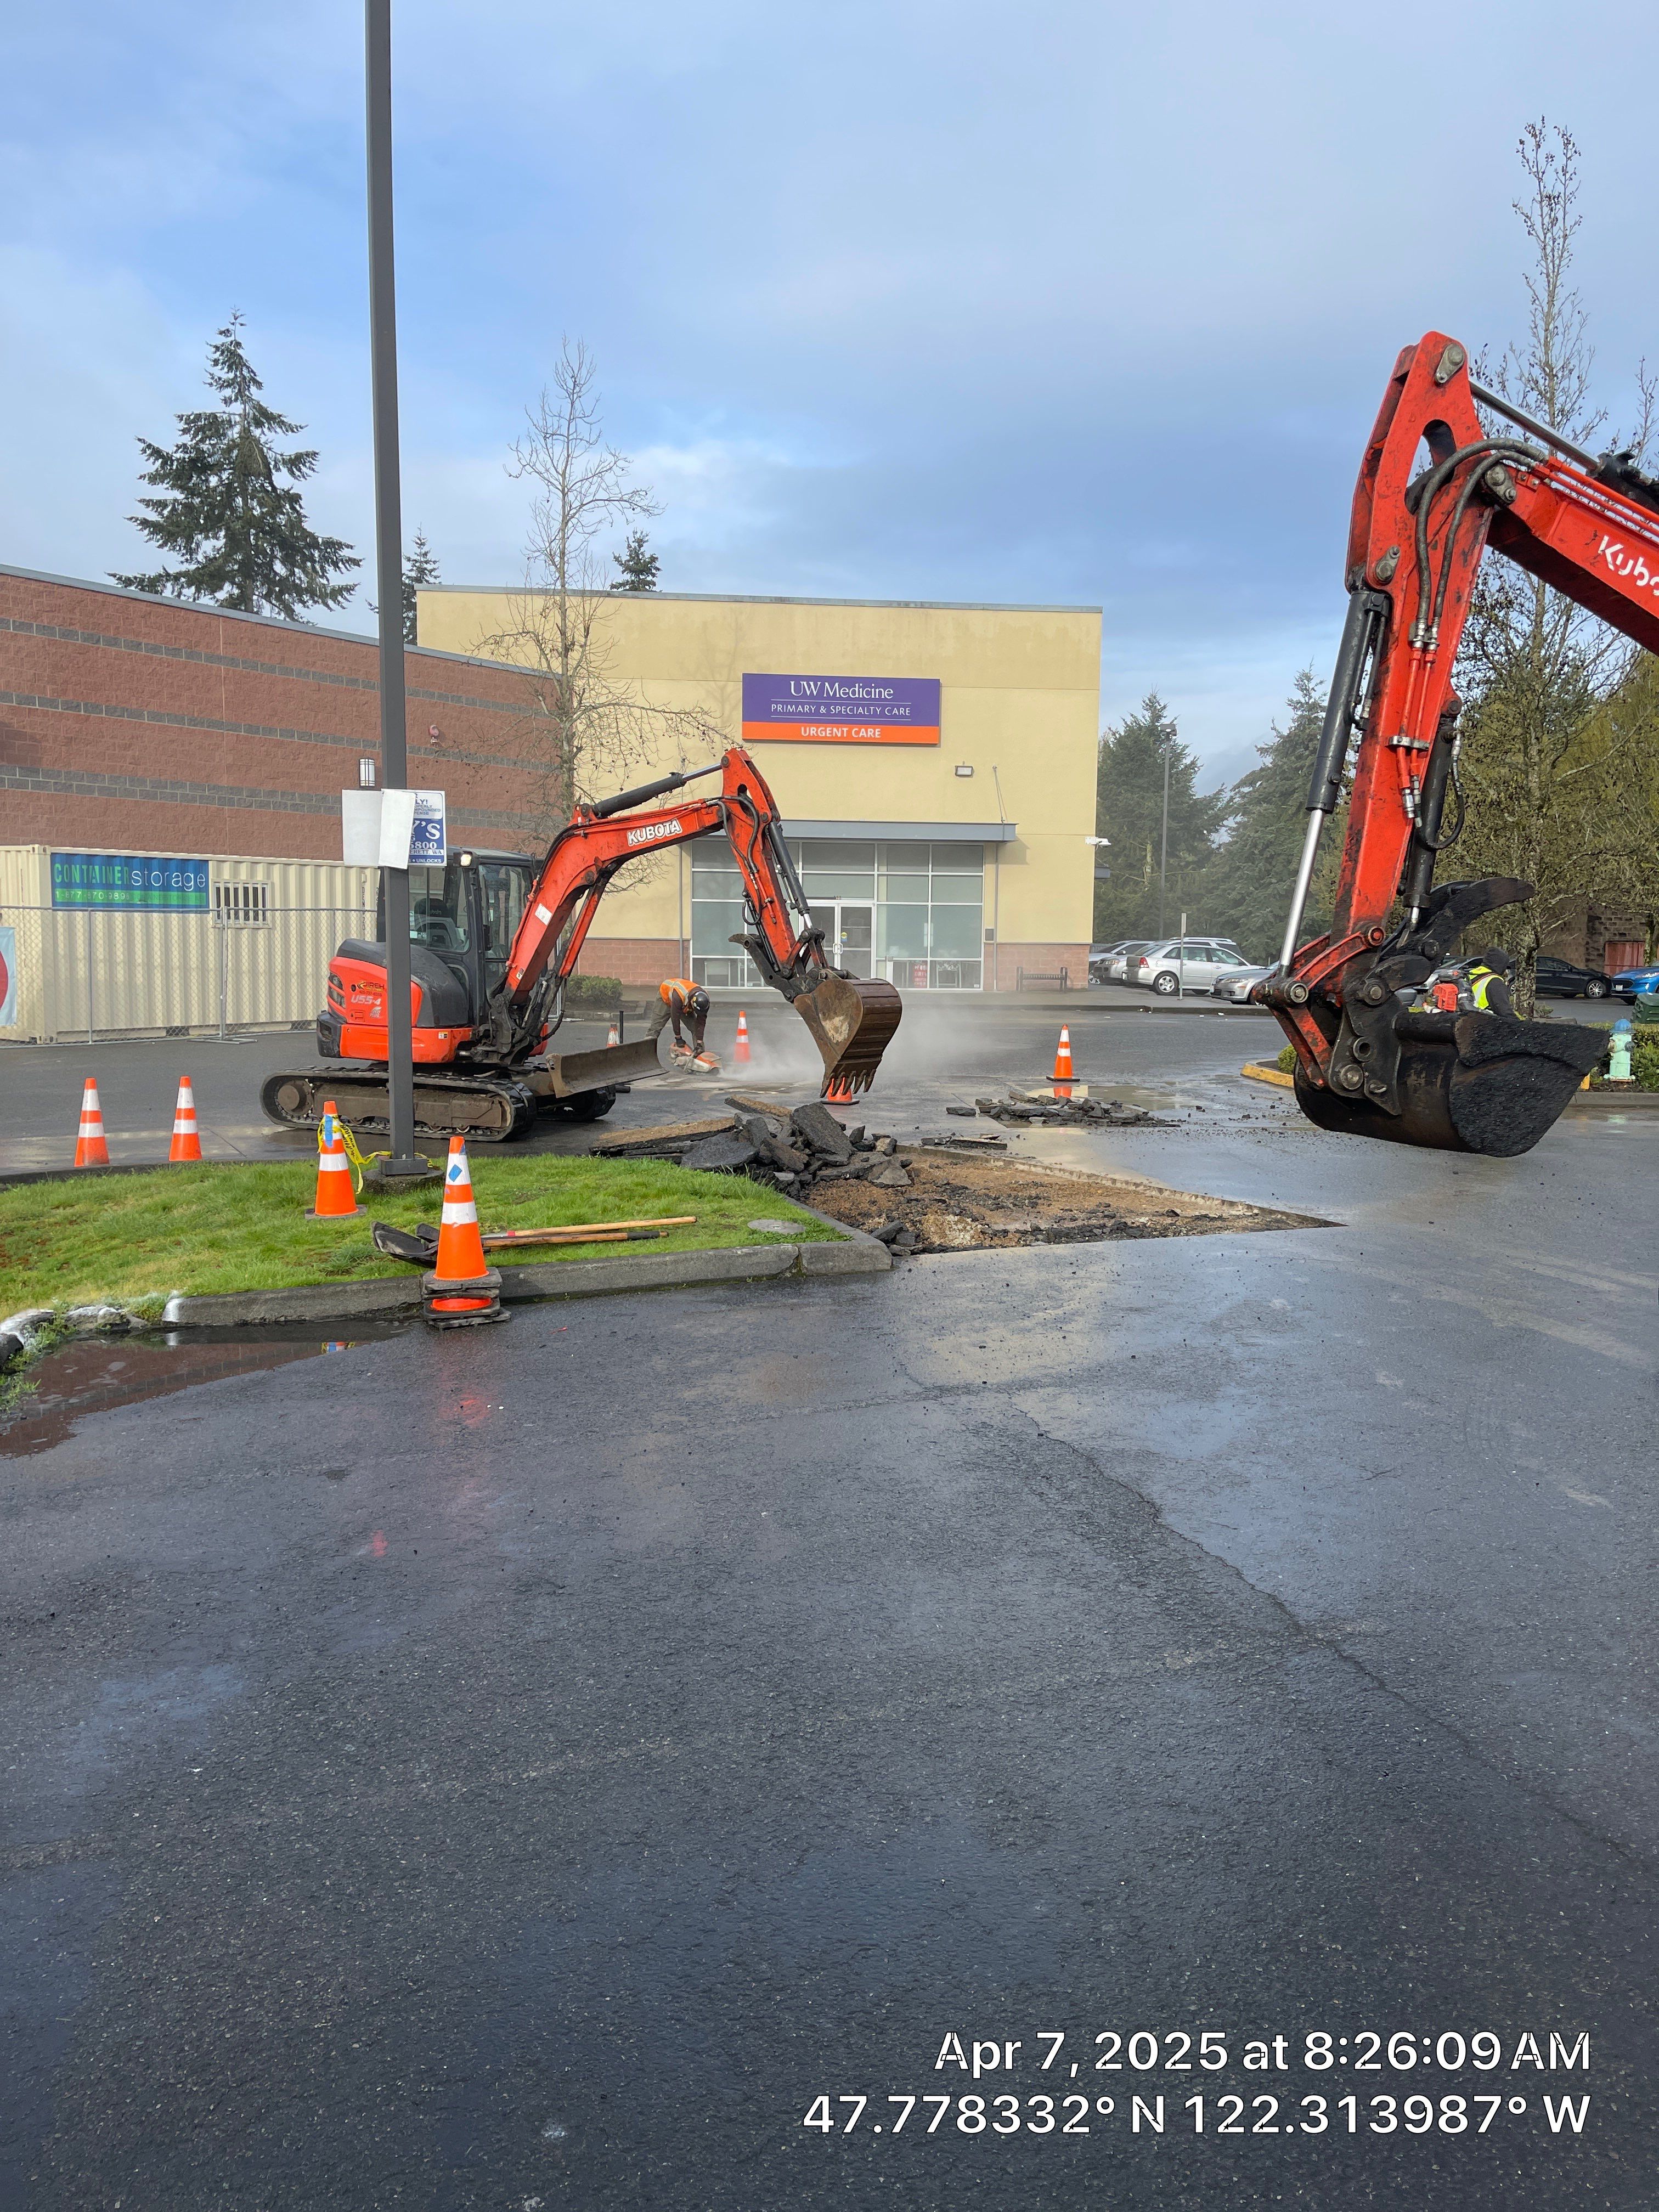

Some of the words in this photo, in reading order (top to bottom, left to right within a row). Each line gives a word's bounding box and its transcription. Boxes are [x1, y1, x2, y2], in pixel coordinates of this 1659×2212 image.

[1598, 535, 1659, 596] Kubo
[790, 681, 822, 696] UW
[823, 682, 894, 699] Medicine
[771, 704, 816, 713] PRIMARY
[820, 706, 827, 714] &
[830, 706, 882, 715] SPECIALTY
[885, 707, 911, 716] CARE
[801, 726, 849, 737] URGENT
[851, 727, 881, 738] CARE
[411, 820, 441, 840] Y'S
[628, 819, 681, 845] KUBOTA
[54, 863, 130, 884] CONTAINER
[131, 868, 206, 891] storage
